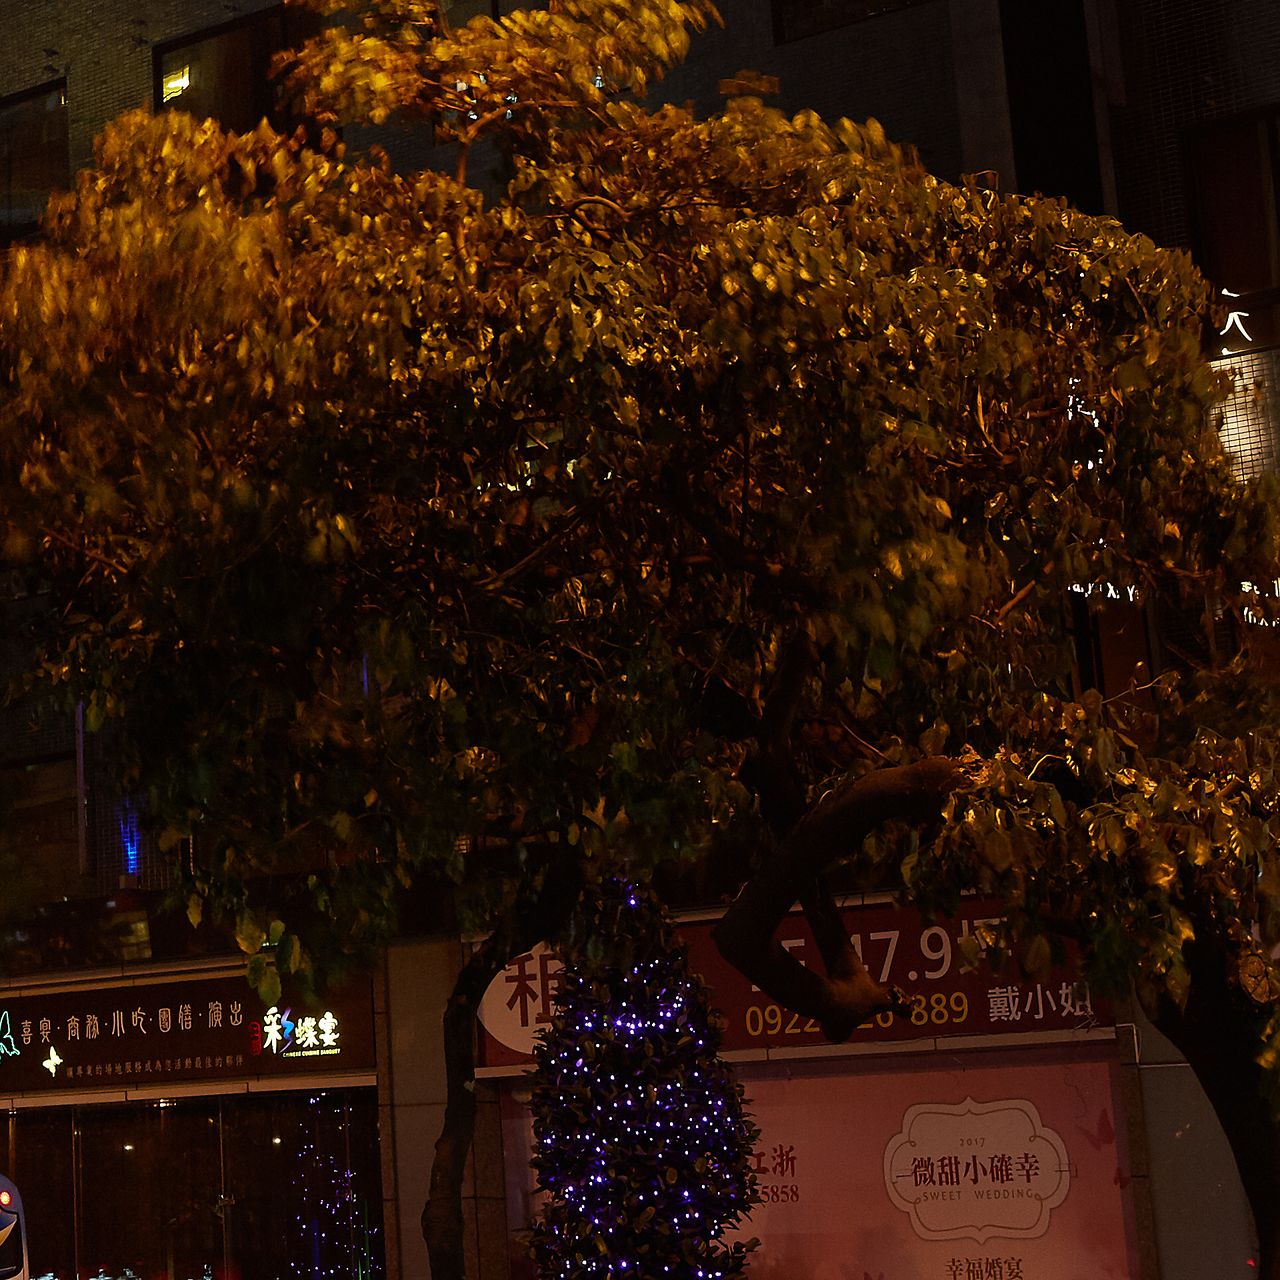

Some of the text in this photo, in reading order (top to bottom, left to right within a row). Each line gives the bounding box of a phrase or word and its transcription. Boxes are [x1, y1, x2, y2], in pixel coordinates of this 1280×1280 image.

[263, 1006, 340, 1054] 彩蝶宴
[959, 1137, 986, 1148] 2017
[911, 1152, 1040, 1187] 微甜小確幸
[921, 1188, 1034, 1202] SWEET WEDDING
[945, 1257, 1024, 1280] 幸福婚宴
